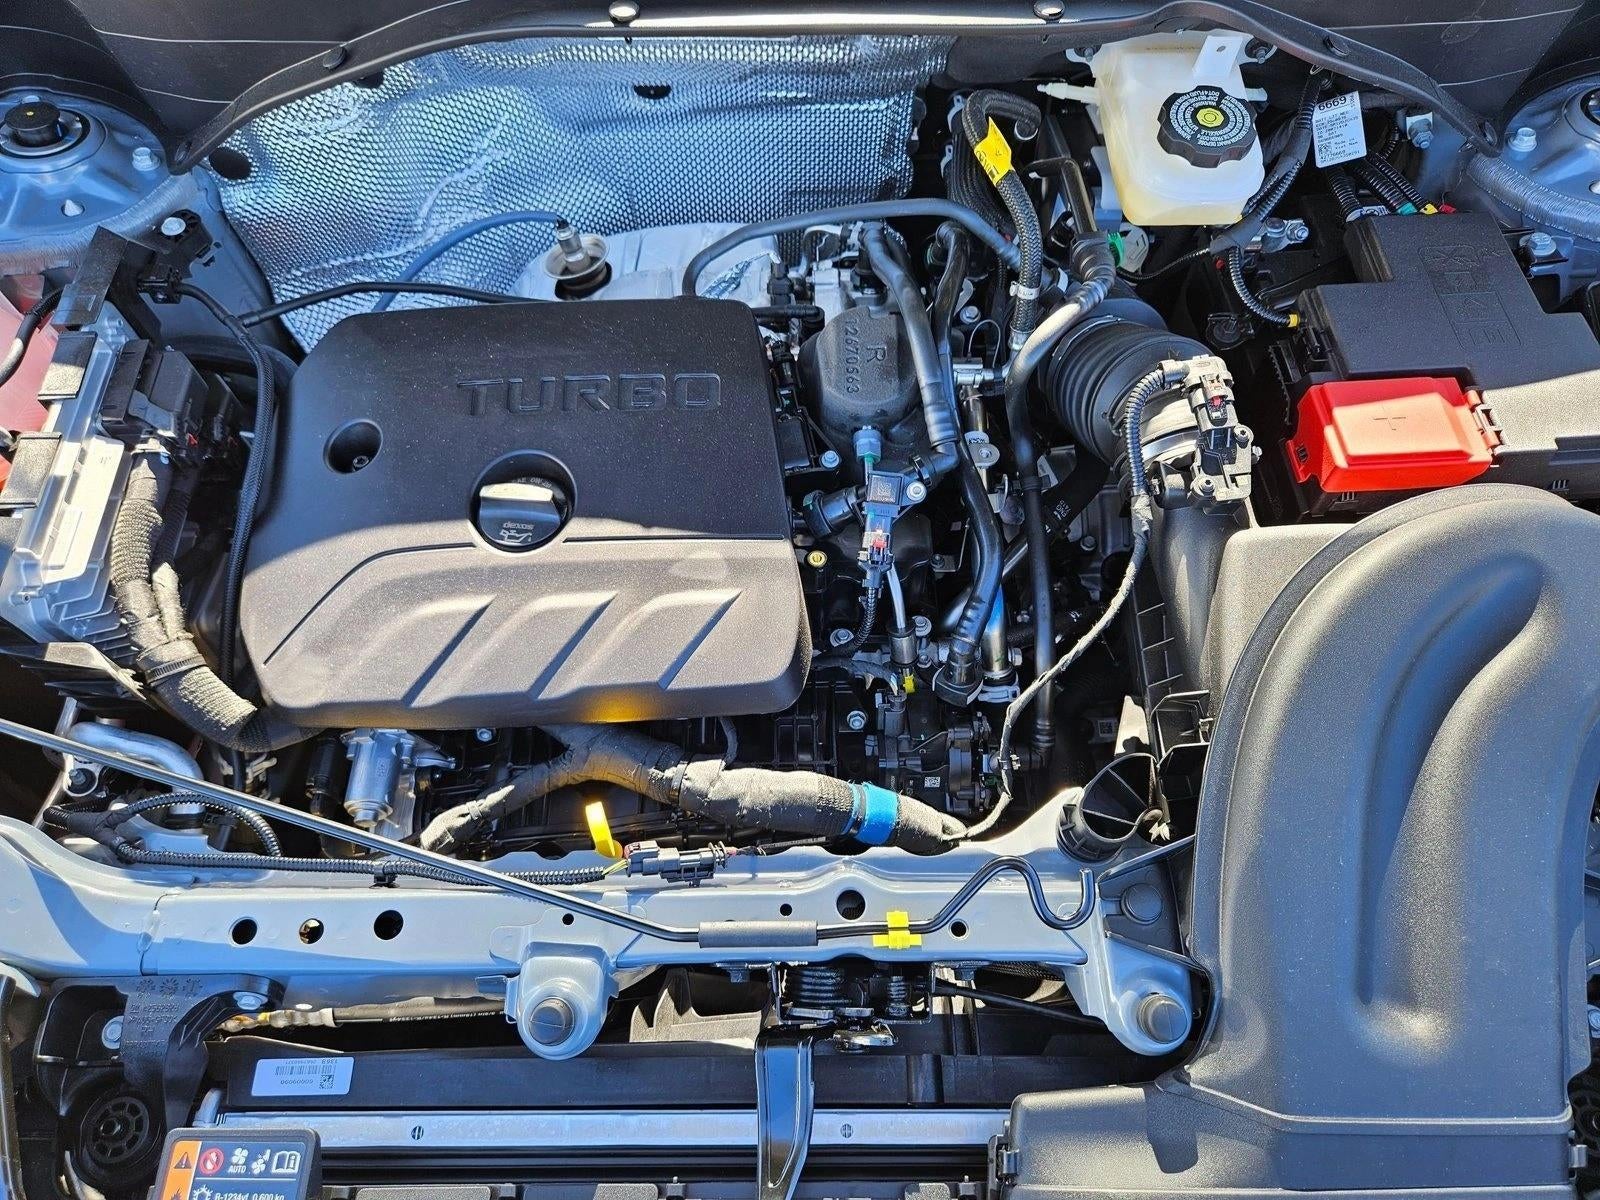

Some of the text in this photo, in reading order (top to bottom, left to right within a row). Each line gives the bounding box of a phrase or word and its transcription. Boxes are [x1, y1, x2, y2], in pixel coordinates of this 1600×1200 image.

[1318, 96, 1347, 111] 6669
[867, 346, 887, 363] R
[457, 373, 721, 416] TURBO
[228, 1165, 247, 1174] AUTO
